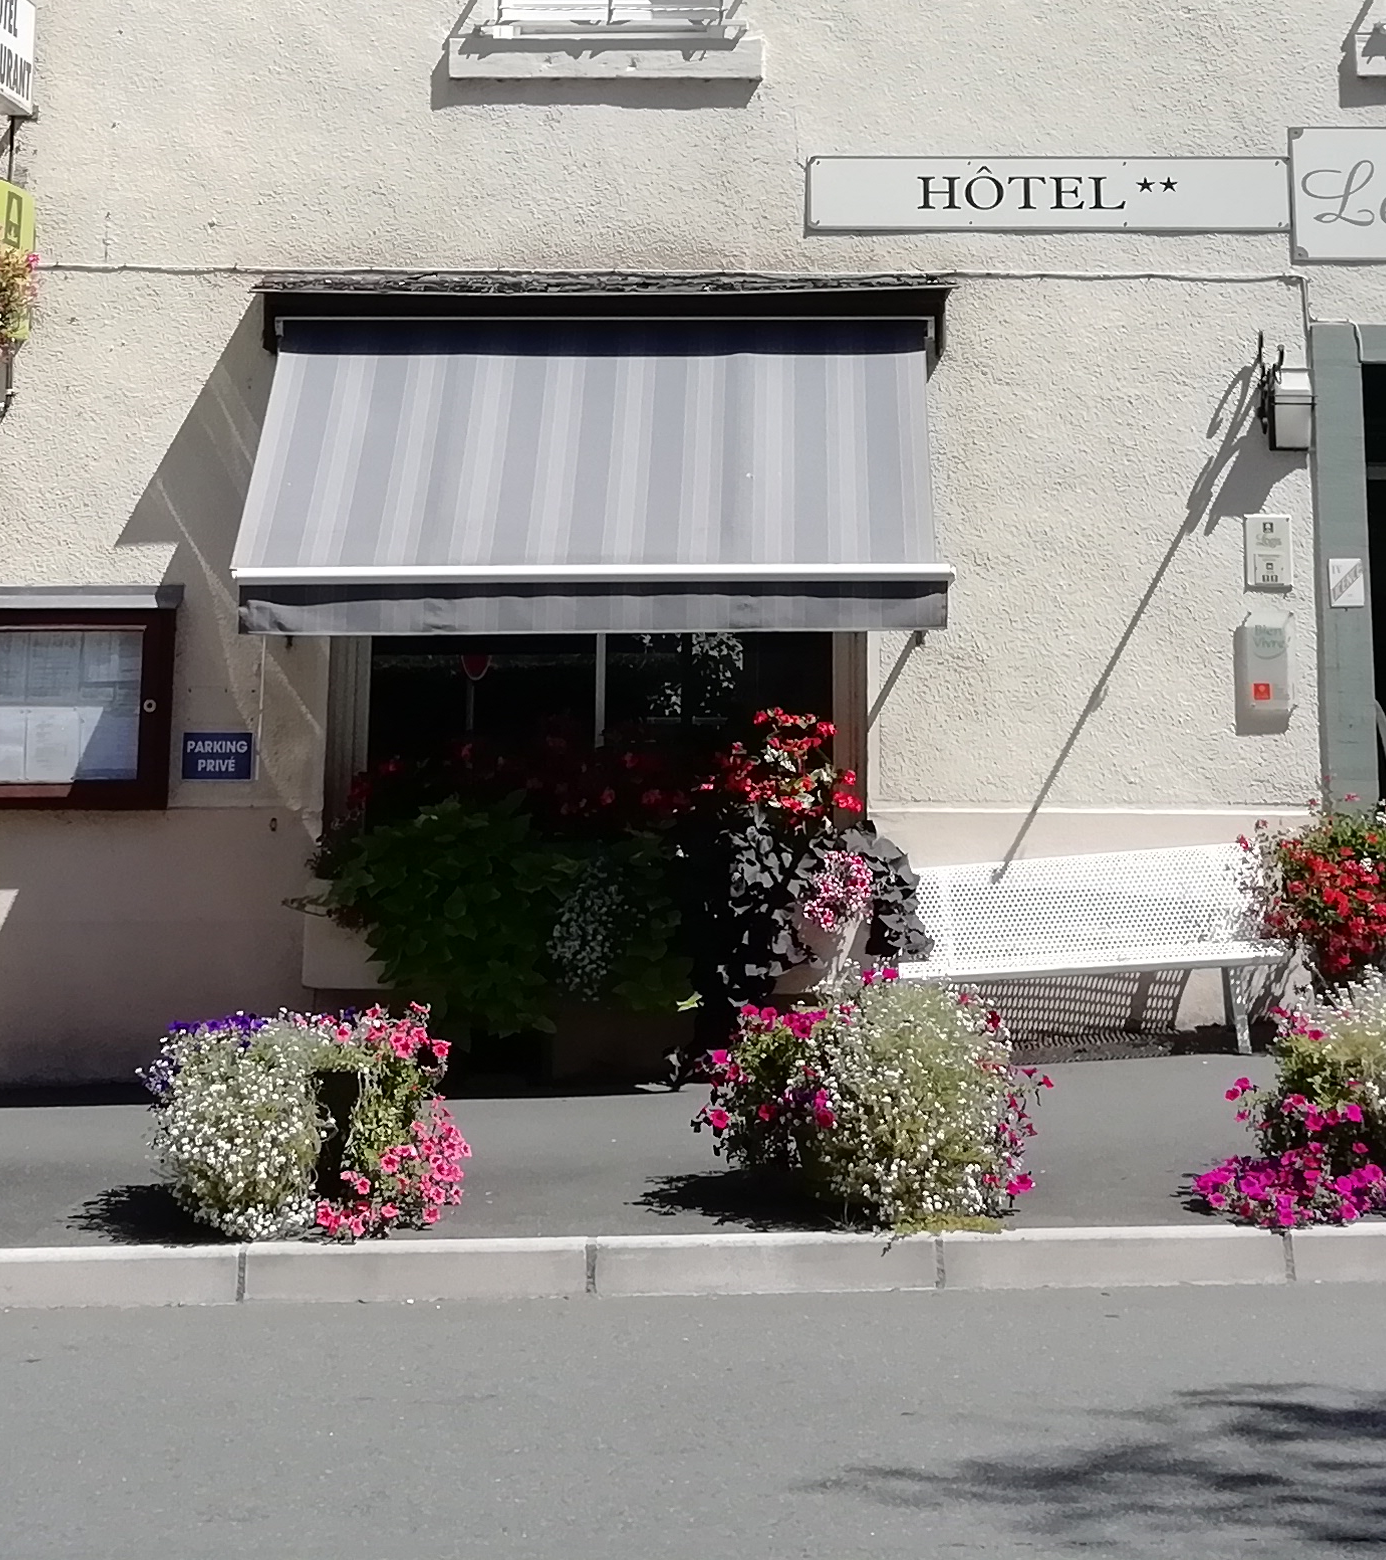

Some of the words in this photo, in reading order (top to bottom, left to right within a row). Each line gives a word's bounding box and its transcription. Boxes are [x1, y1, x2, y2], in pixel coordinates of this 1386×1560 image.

[916, 165, 1127, 211] HÔTEL
[186, 740, 248, 754] PARKING
[197, 756, 236, 772] PRIVÉ
